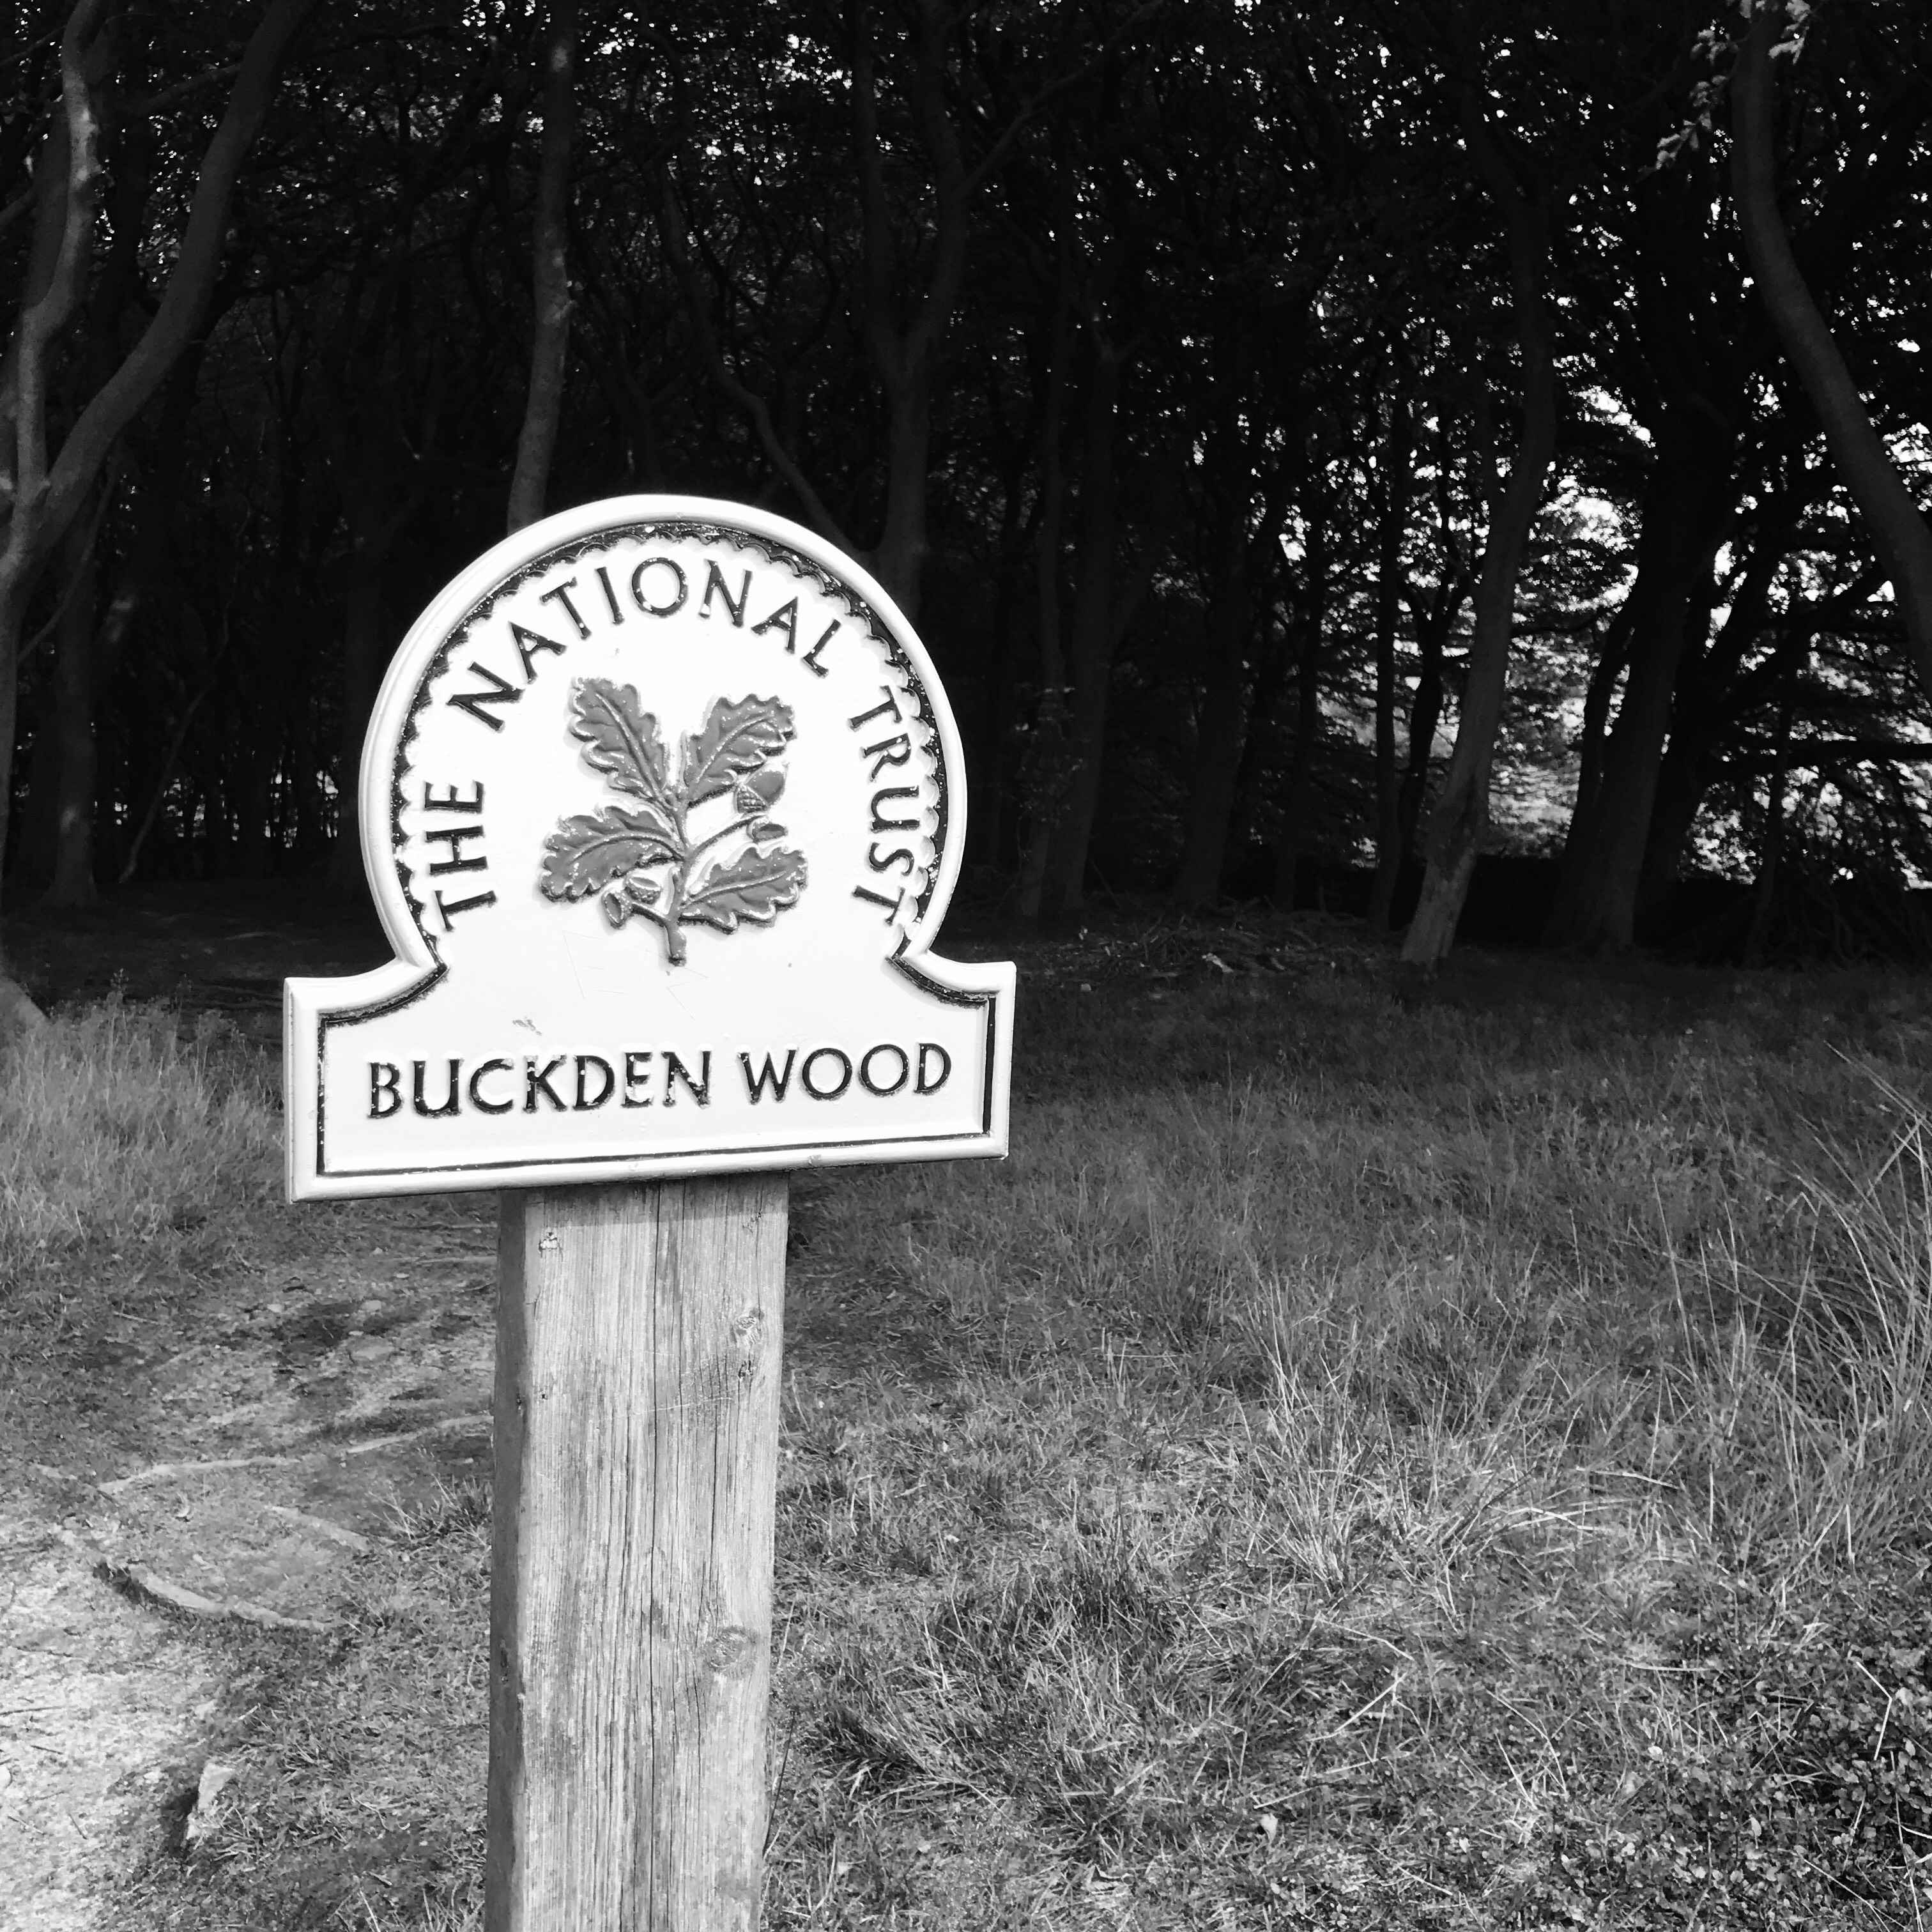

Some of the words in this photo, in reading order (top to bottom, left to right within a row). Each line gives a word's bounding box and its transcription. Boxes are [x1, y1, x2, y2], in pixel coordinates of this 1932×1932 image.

[447, 556, 841, 732] NATIONAL
[424, 781, 497, 932] THE
[847, 684, 921, 926] TRUST
[367, 1048, 714, 1119] BUCKDEN
[737, 1042, 952, 1105] WOOD
